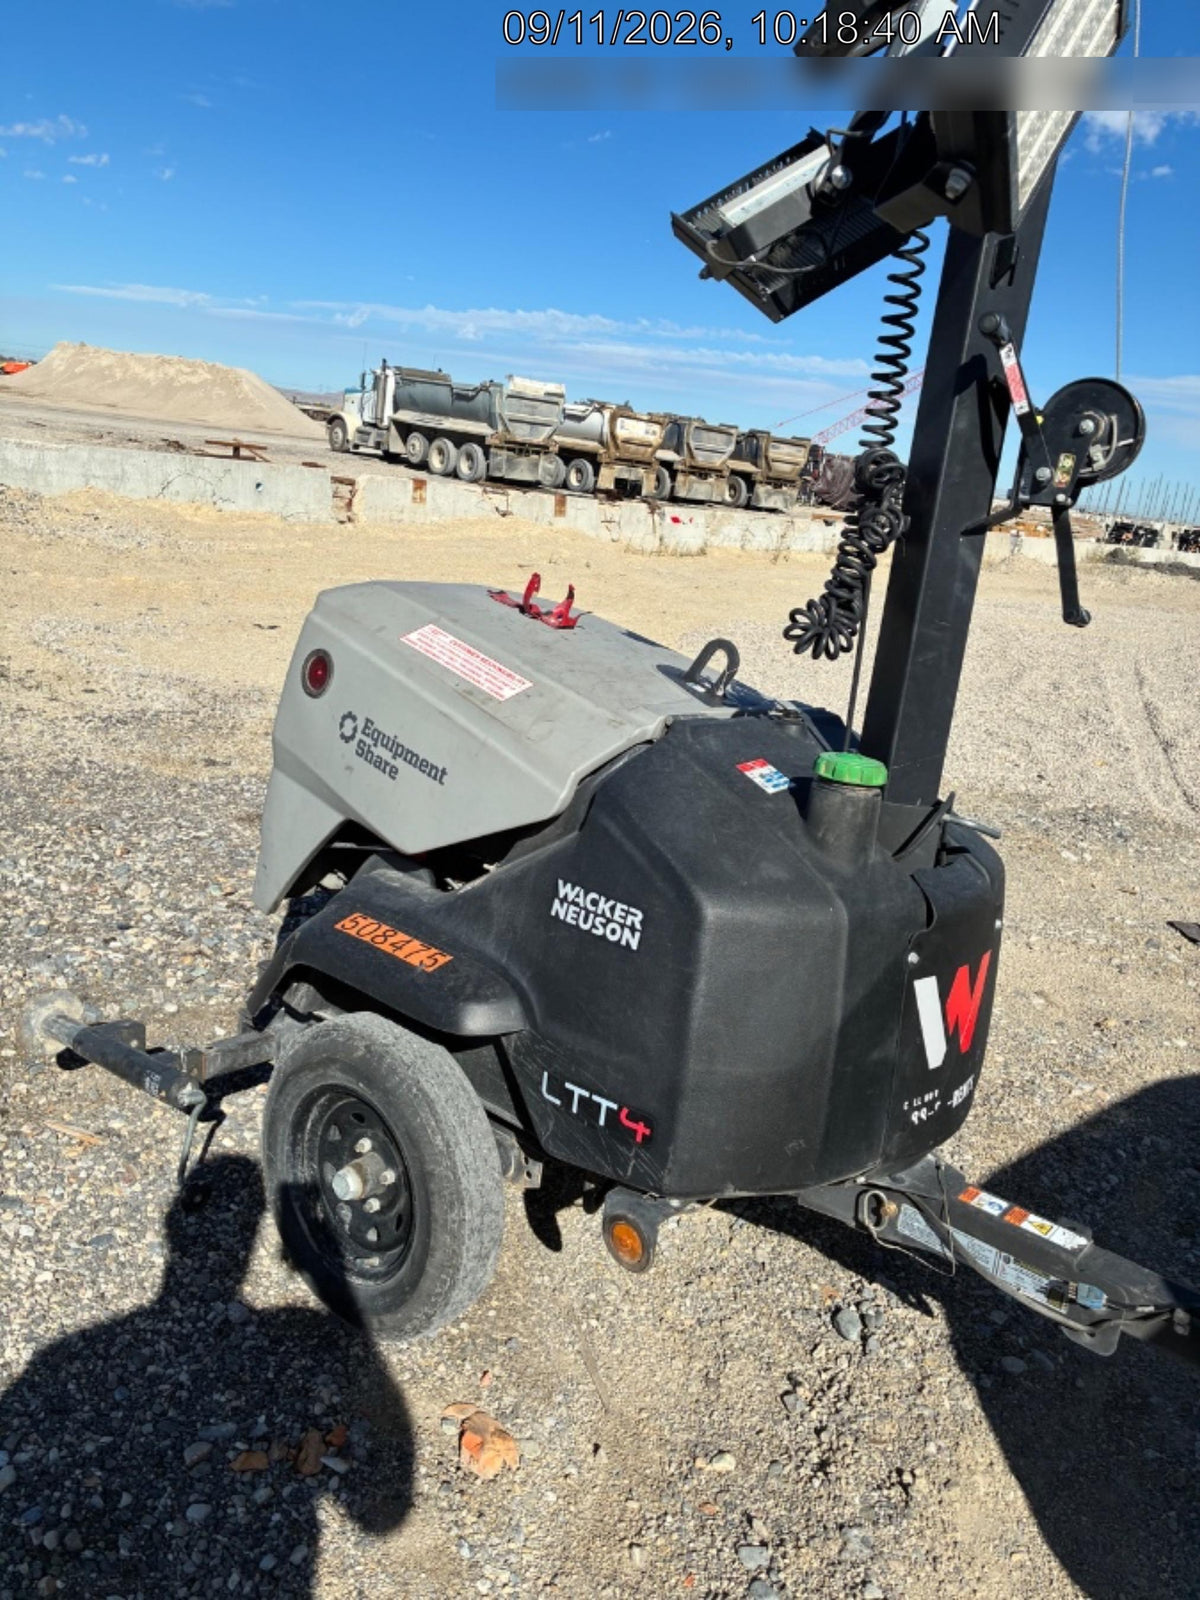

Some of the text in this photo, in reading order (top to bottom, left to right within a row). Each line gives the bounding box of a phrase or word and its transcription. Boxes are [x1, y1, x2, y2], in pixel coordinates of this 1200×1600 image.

[355, 738, 399, 780] Share
[360, 717, 448, 786] Equipment
[550, 898, 640, 951] NEUSON
[557, 877, 644, 931] WACKER
[340, 914, 450, 969] 508475
